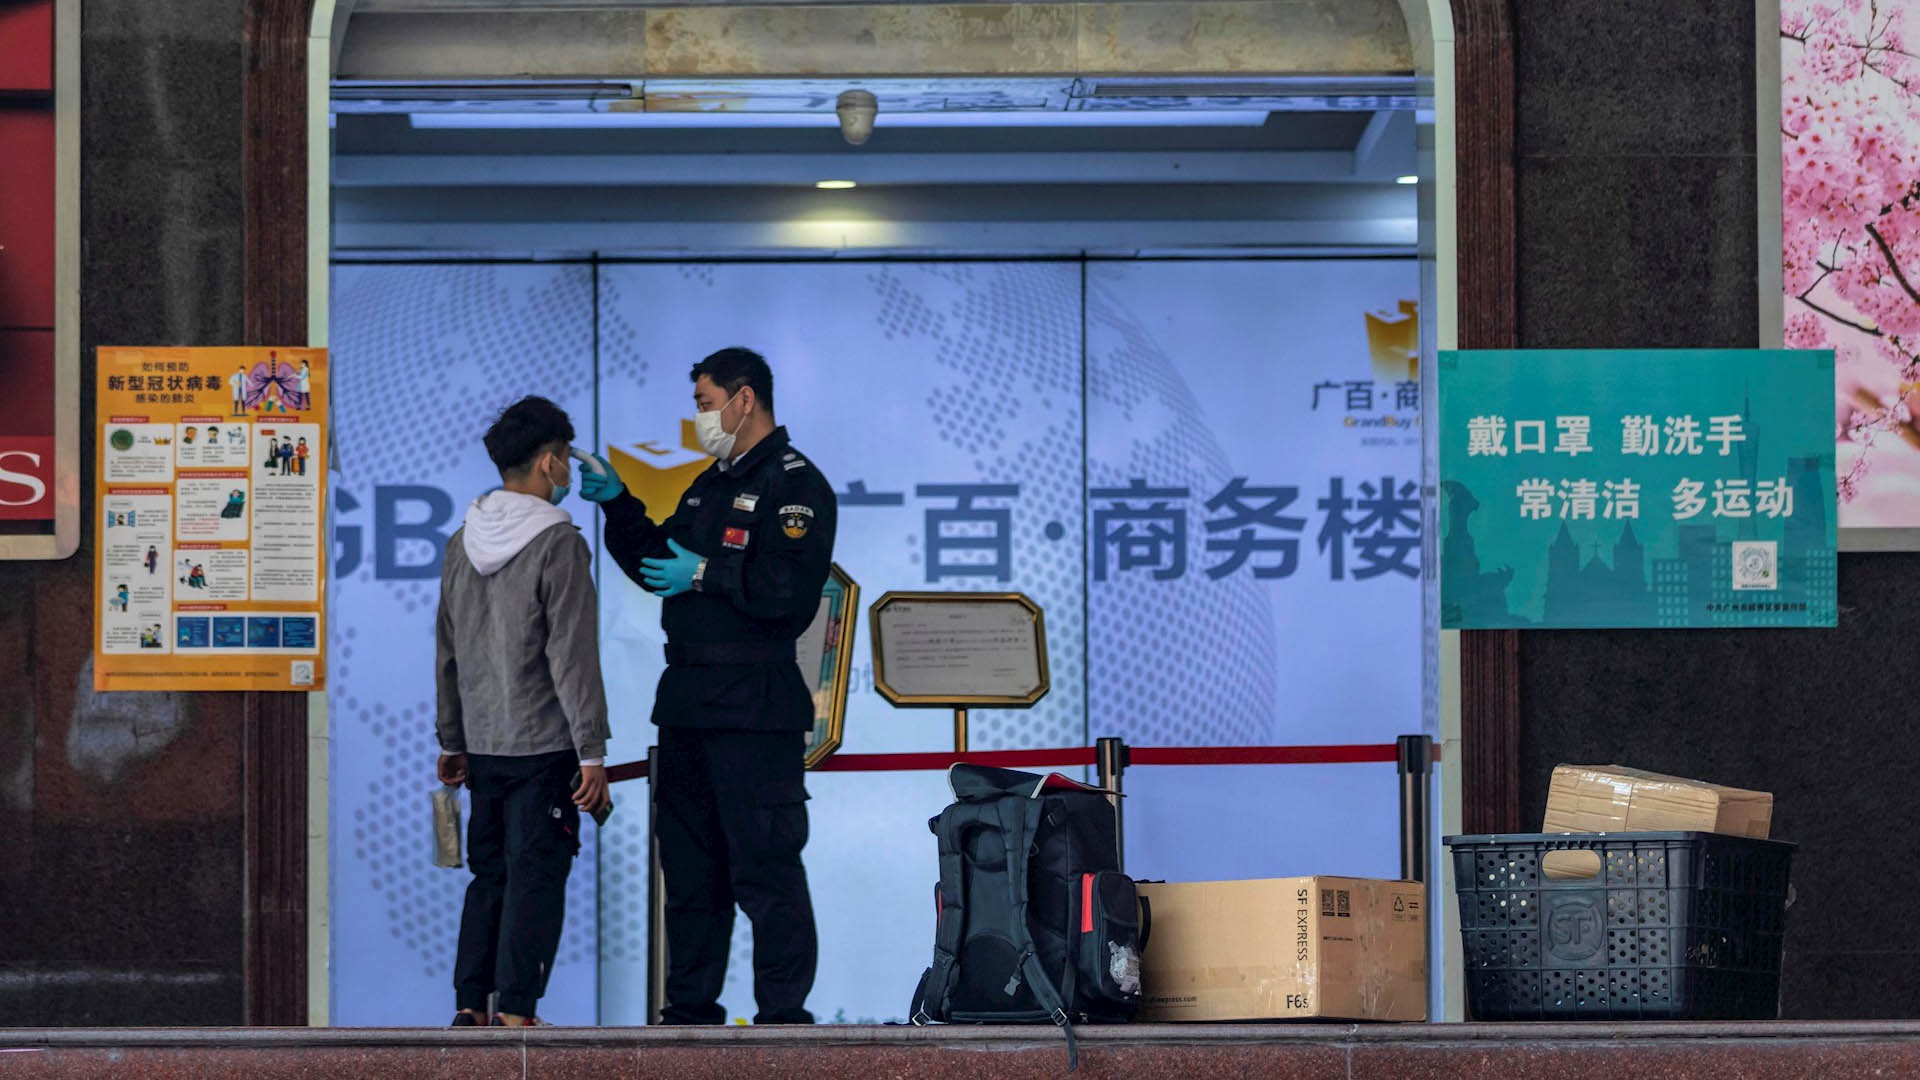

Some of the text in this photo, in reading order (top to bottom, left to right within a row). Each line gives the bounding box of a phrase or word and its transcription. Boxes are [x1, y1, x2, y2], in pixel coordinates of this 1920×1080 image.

[108, 375, 222, 391] 新型冠状病毒
[1467, 414, 1747, 457] 戴口罩 勤洗手
[1516, 477, 1794, 520] 常清洁 多运动
[1297, 888, 1308, 961] SF EXPRESS
[1286, 994, 1309, 1009] F6s
